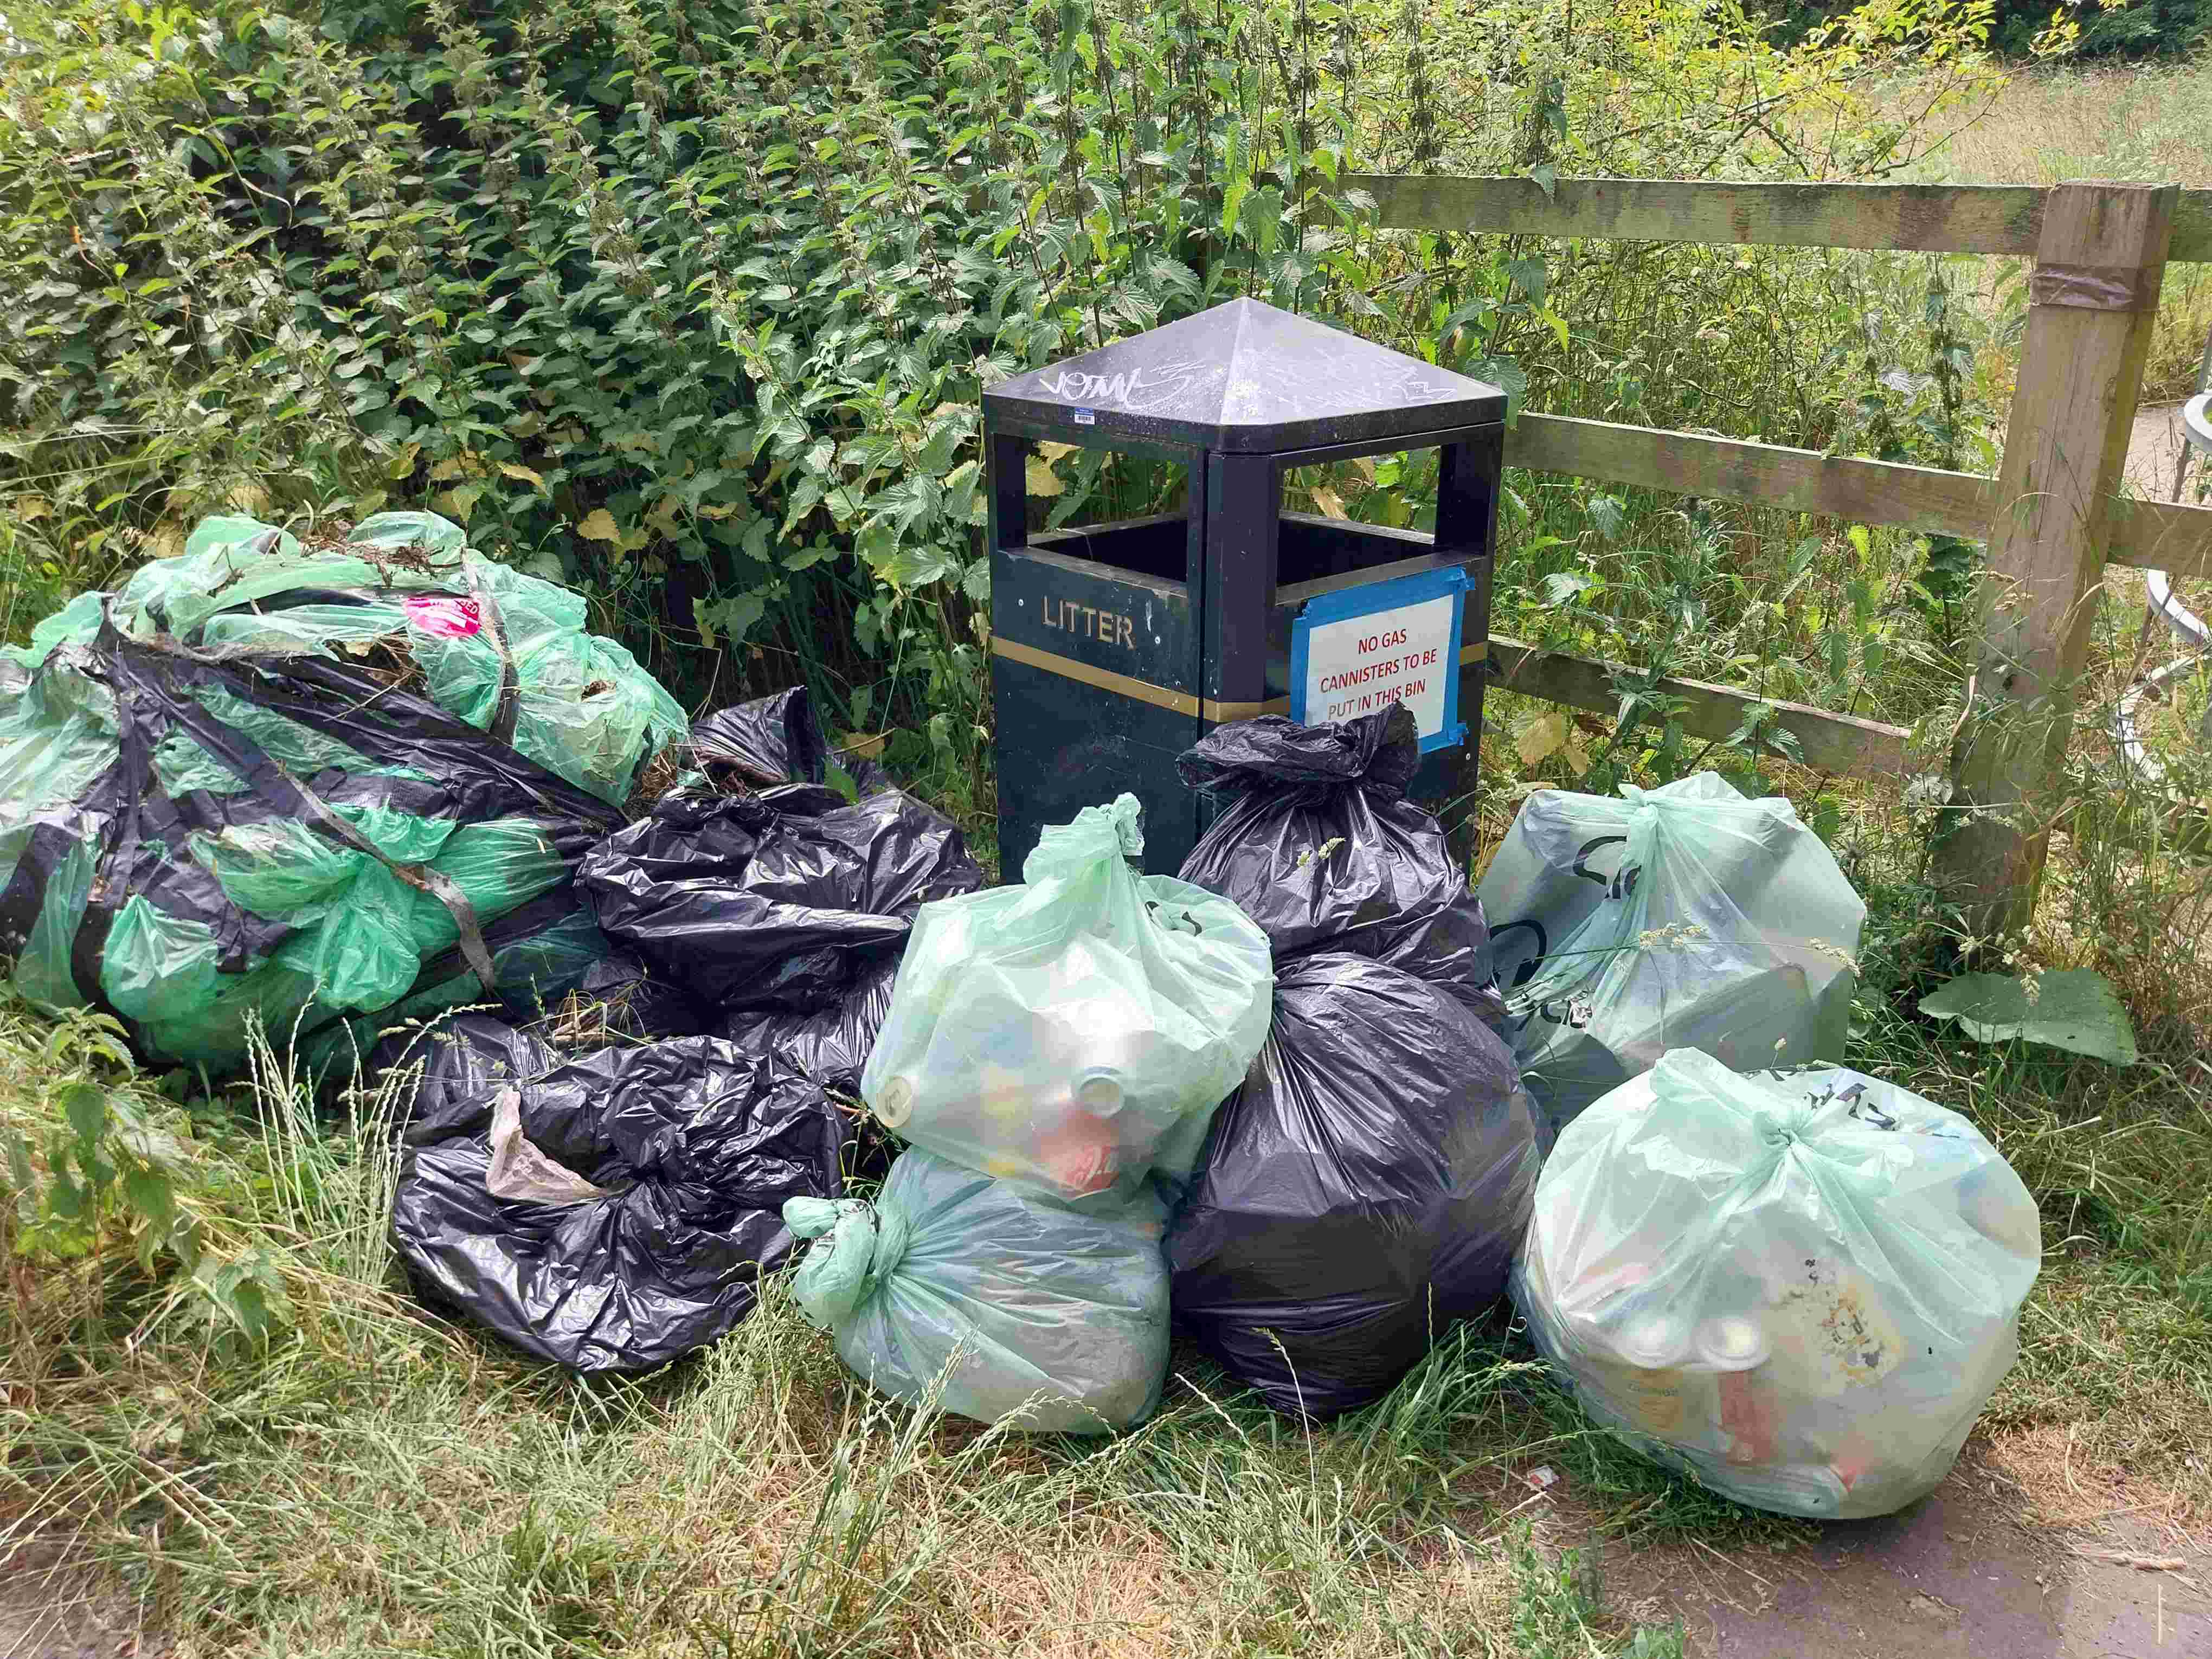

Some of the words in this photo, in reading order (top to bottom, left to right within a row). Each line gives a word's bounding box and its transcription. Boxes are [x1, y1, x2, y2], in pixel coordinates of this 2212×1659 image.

[1041, 595, 1135, 649] LITTER
[1358, 636, 1378, 654] NO
[1382, 628, 1407, 648] GAS
[1320, 659, 1400, 693] CANNISTERS
[1403, 653, 1419, 671] TO
[1422, 648, 1437, 666] BE
[1328, 699, 1355, 720] PUT
[1358, 694, 1371, 712] IN
[1375, 685, 1401, 707] THIS
[1405, 678, 1426, 698] BIN
